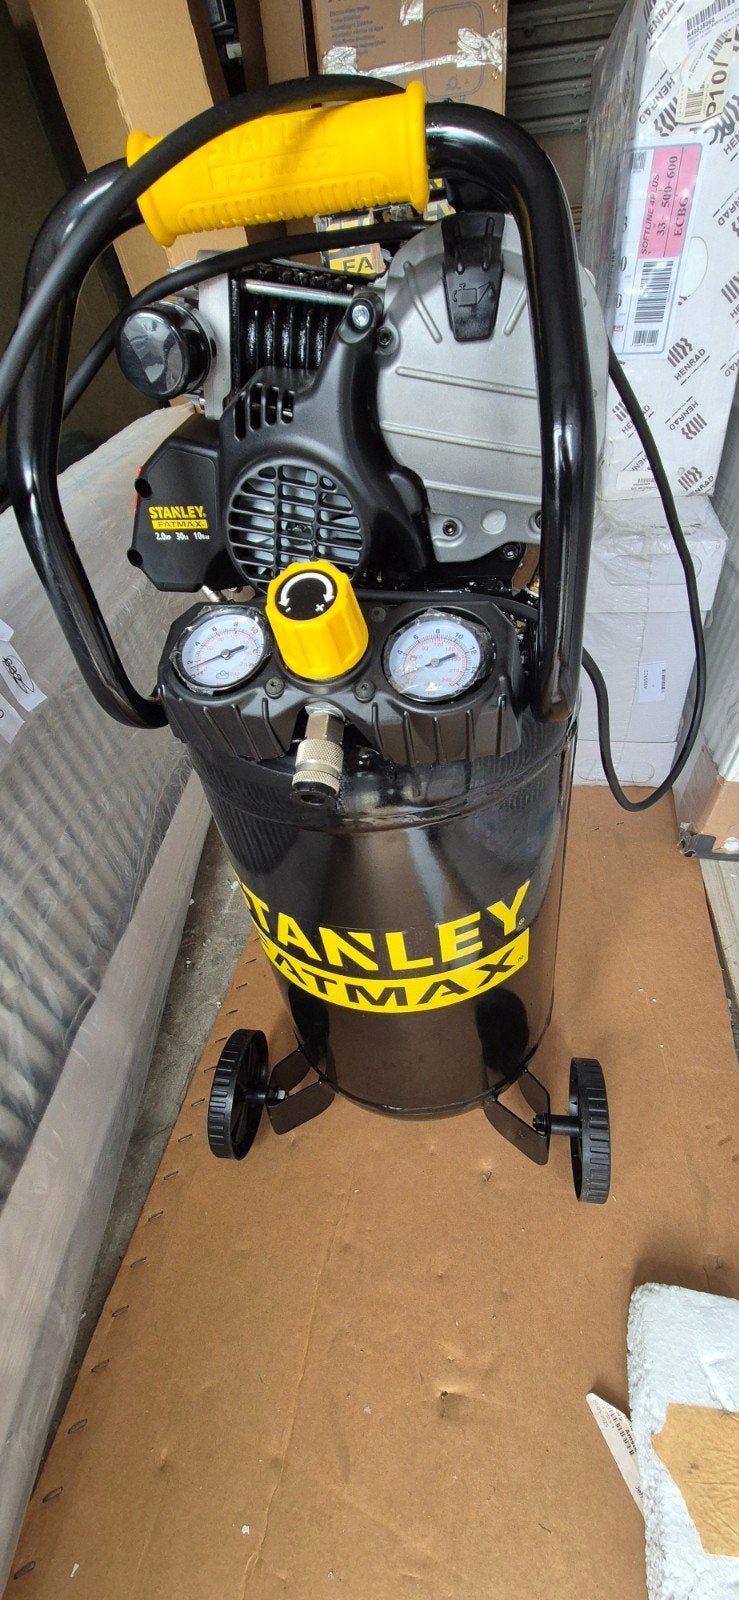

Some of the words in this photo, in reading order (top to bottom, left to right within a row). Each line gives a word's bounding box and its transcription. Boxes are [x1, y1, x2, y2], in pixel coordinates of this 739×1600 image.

[641, 208, 655, 255] SOFTLINE
[674, 348, 706, 380] HENRAD
[669, 400, 699, 431] HENRAD
[148, 505, 204, 520] STANLEY
[158, 520, 203, 528] FATMAX
[454, 632, 464, 640] 10
[469, 646, 478, 655] 12
[238, 879, 531, 972] TANLEY
